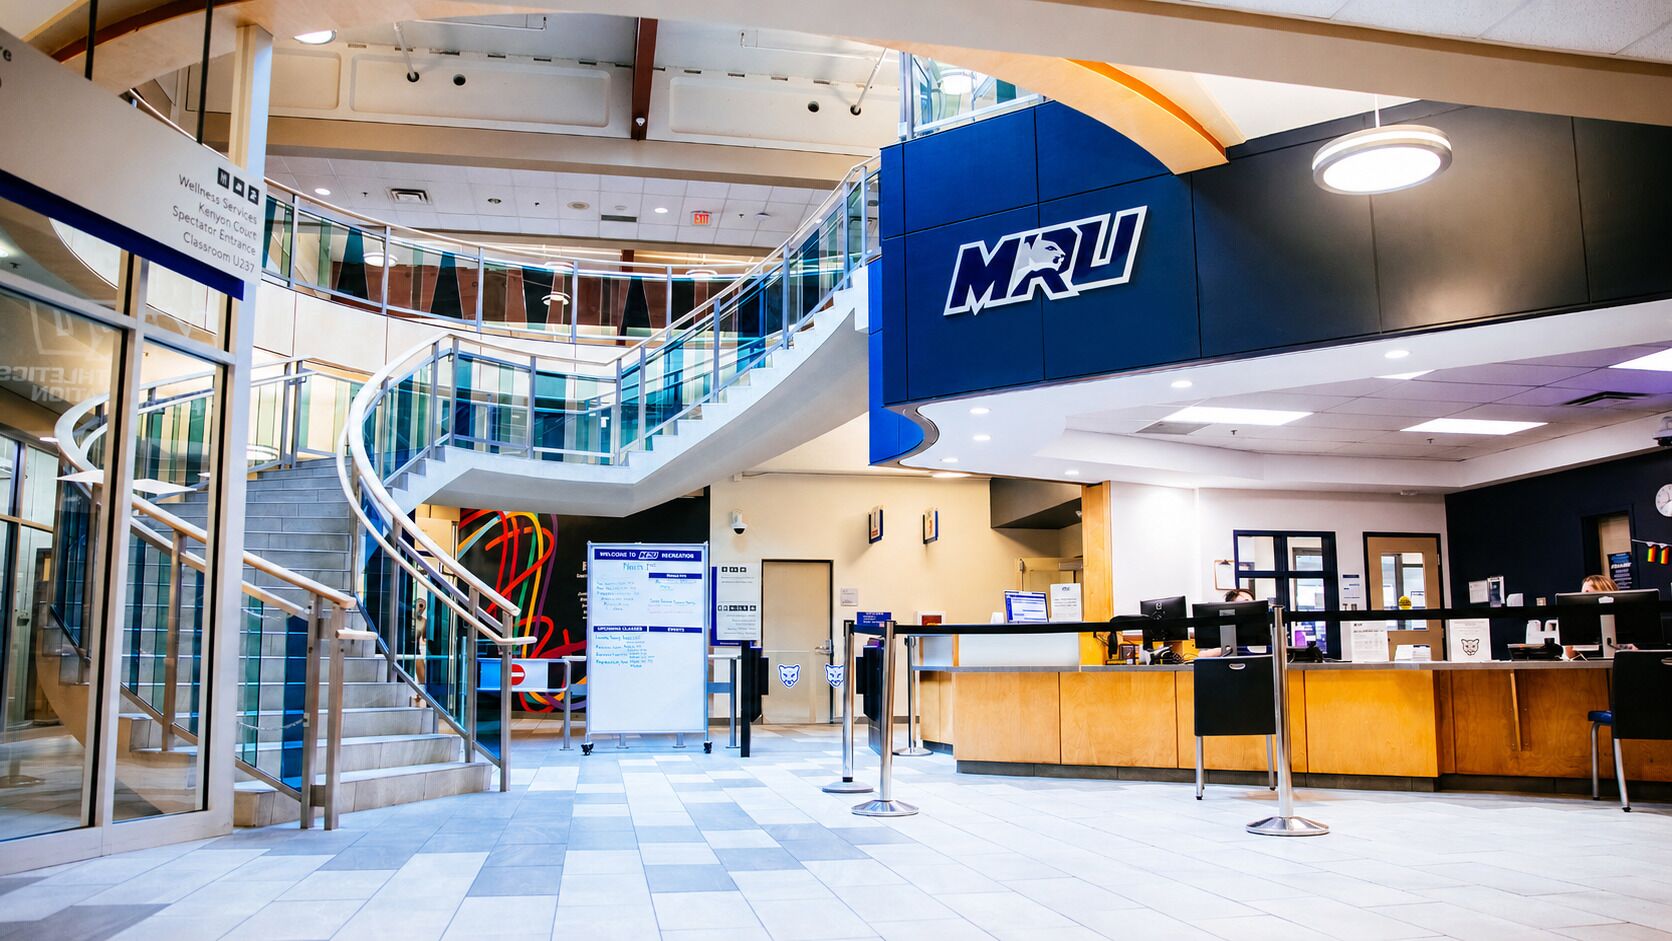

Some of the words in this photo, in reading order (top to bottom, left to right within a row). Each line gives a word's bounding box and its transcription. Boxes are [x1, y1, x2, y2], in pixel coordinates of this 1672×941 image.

[179, 173, 220, 205] Wellness
[222, 198, 257, 225] Services
[199, 202, 231, 227] Kenyon
[233, 220, 257, 240] Court
[172, 205, 217, 236] Spectator
[219, 228, 256, 256] Entrance
[183, 231, 231, 264] Classroom
[232, 255, 255, 273] U237
[943, 205, 1148, 316] MRU
